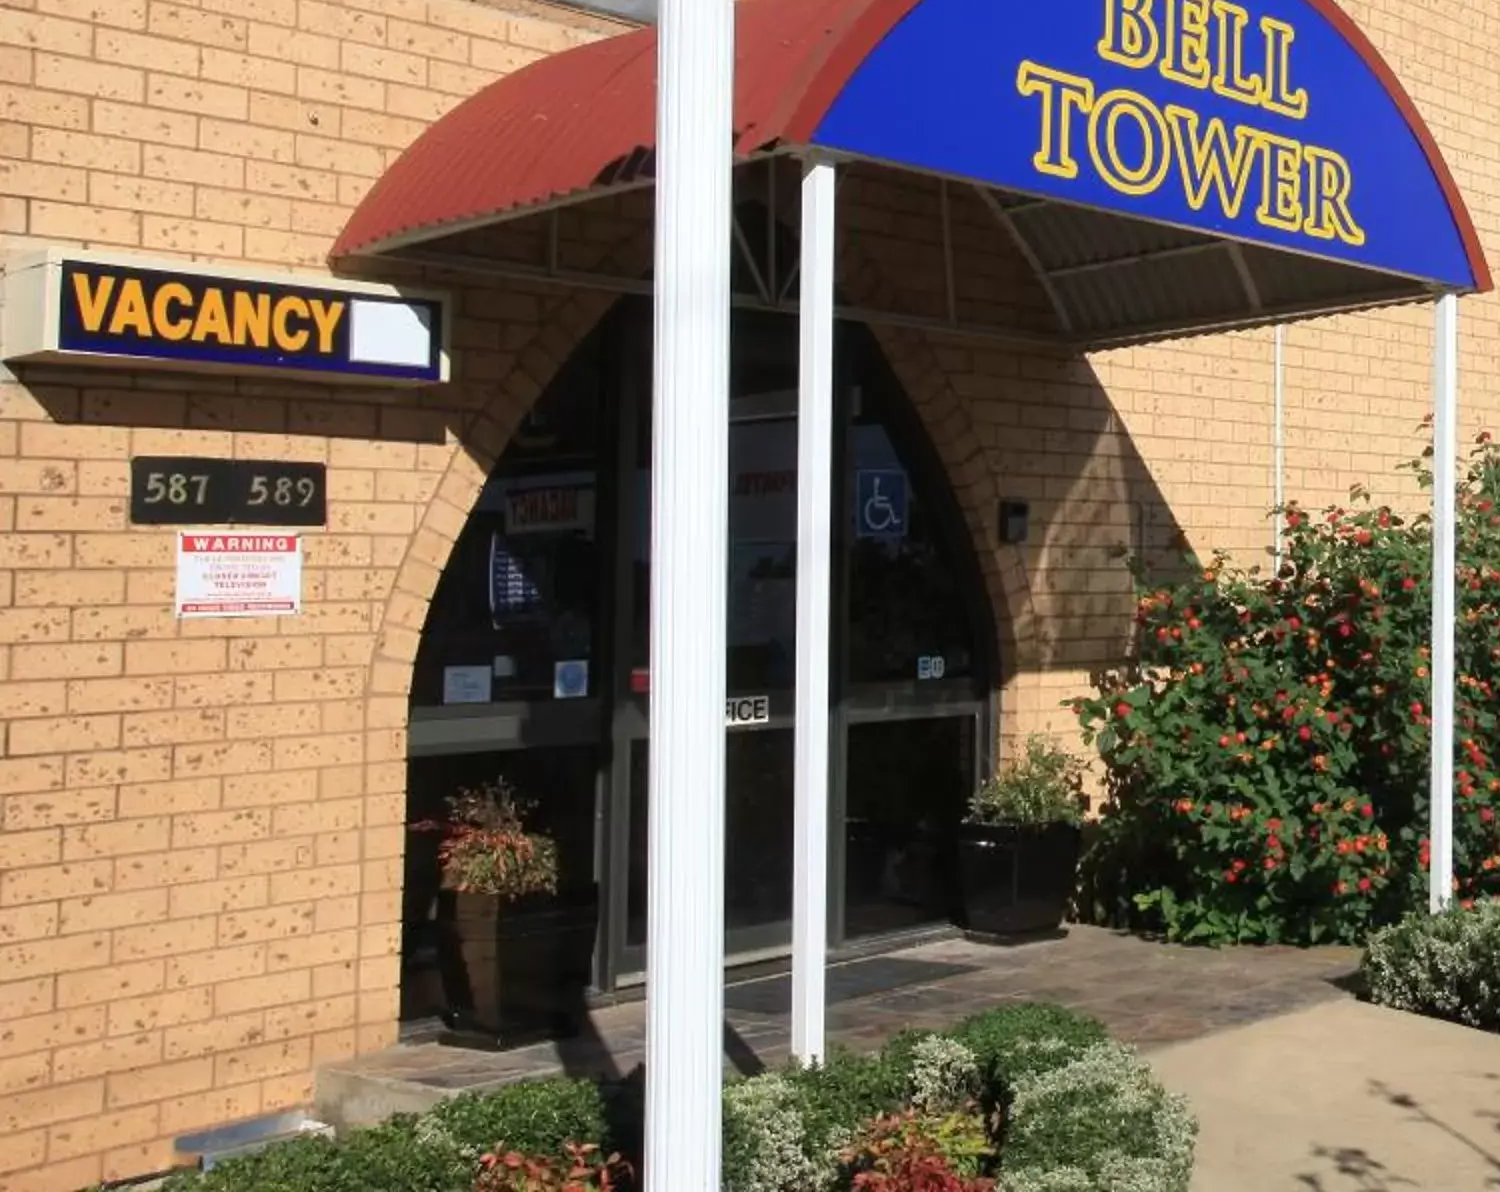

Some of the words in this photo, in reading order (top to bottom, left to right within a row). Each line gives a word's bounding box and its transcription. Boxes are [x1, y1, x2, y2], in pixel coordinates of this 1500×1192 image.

[1015, 59, 1366, 246] TOWER
[72, 272, 345, 353] VACANCY
[144, 472, 210, 505] 587
[246, 476, 315, 507] 589
[193, 537, 288, 552] WARNING
